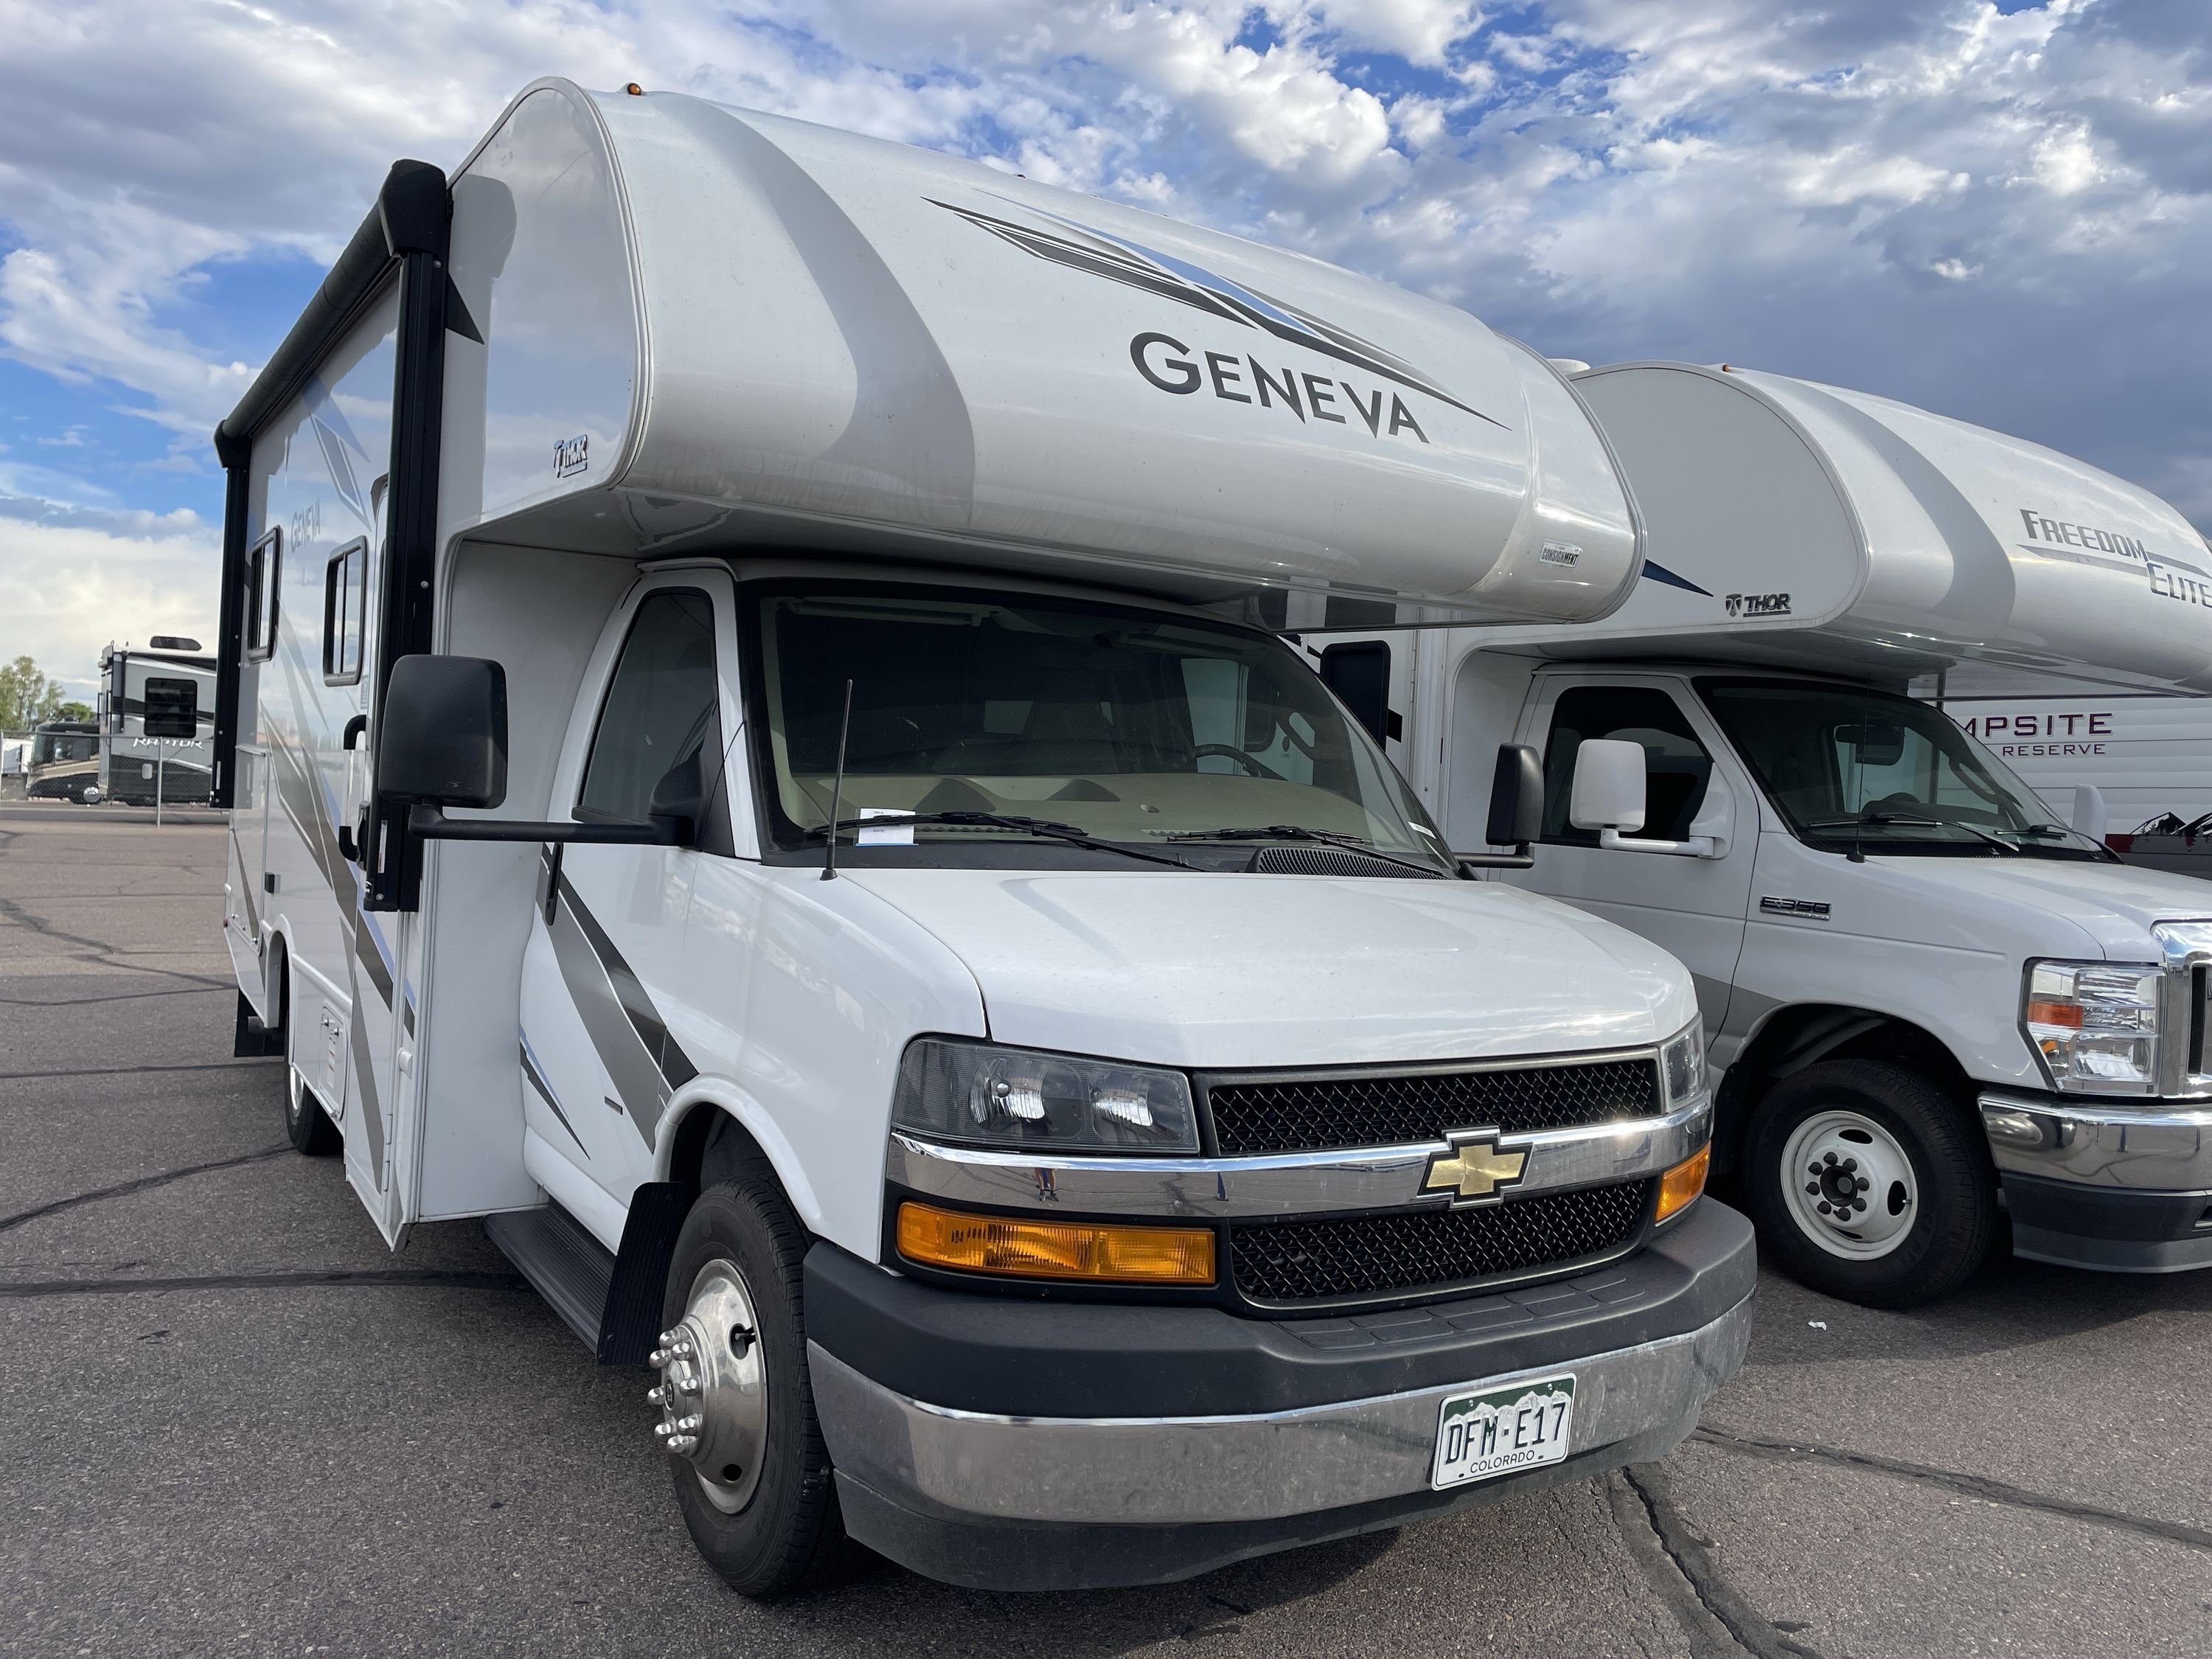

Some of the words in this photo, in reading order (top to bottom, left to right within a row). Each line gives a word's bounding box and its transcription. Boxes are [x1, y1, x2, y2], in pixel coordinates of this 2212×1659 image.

[1130, 332, 1430, 444] GENEVA
[560, 434, 588, 468] THOR
[291, 497, 321, 554] GENEVA
[2020, 509, 2149, 563] FREEDOM
[1541, 548, 1579, 566] CONSIGNMENT
[2146, 563, 2212, 608] ELITE
[1744, 594, 1791, 612] THOR
[2002, 744, 2105, 757] RESERVE
[1470, 1450, 1535, 1473] COLORADO
